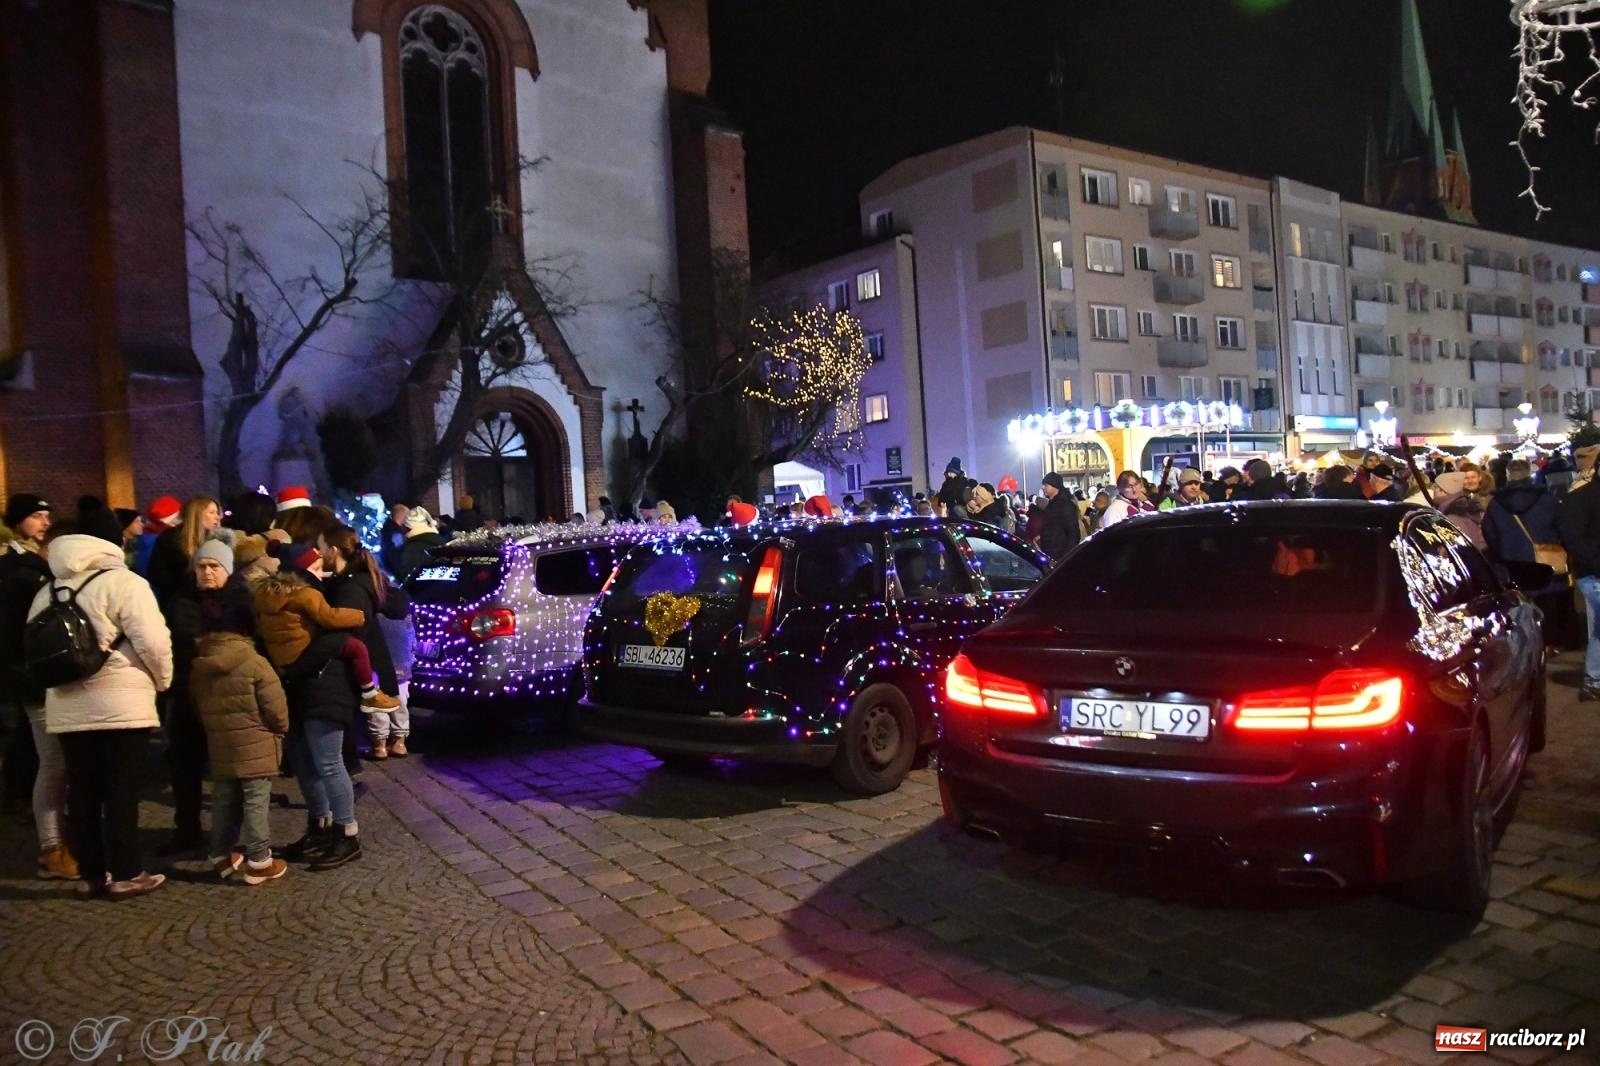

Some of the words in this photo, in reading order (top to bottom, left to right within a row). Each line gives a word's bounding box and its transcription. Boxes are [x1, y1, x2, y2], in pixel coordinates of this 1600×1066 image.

[625, 646, 643, 663] SBL
[648, 648, 684, 666] 46236
[1076, 702, 1123, 728] SRC
[1135, 704, 1202, 733] YL99
